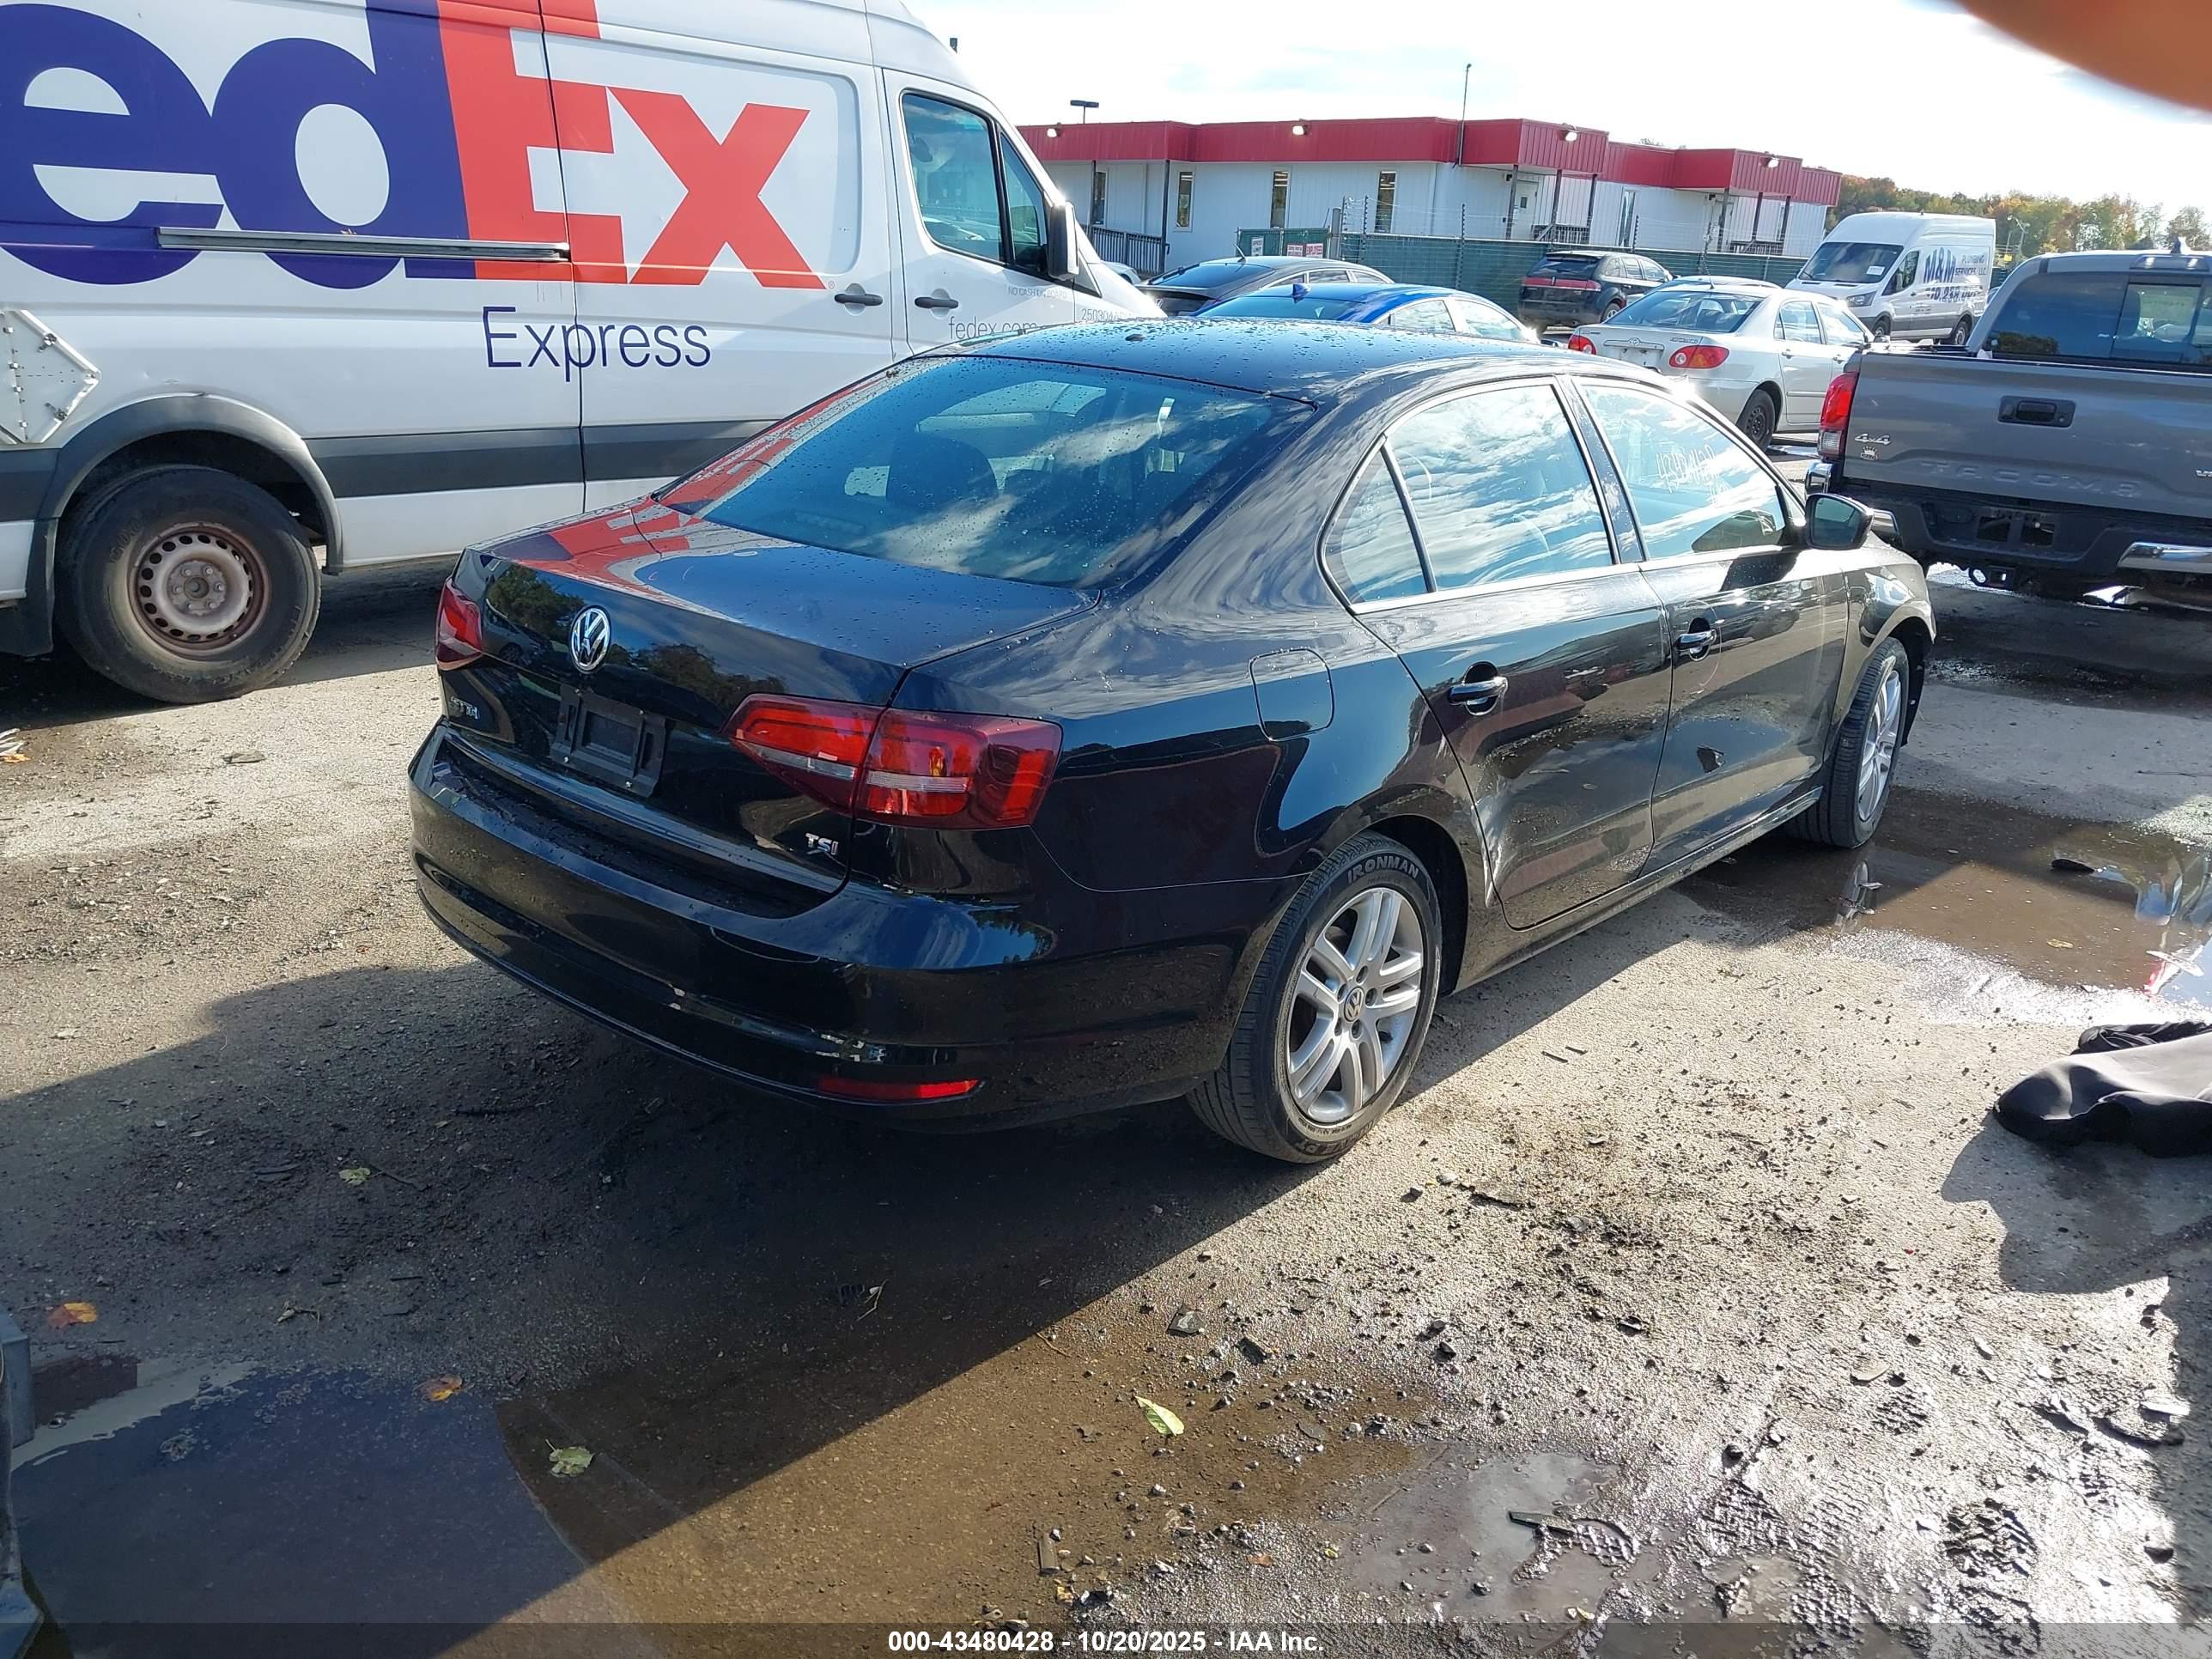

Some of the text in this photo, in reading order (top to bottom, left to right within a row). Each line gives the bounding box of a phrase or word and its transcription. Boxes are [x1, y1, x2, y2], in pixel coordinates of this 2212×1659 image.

[1923, 247, 1956, 283] M&M
[1008, 287, 1018, 295] NO
[1018, 288, 1036, 297] CASH
[483, 306, 711, 383] Express
[1921, 460, 2143, 499] TACOMA
[805, 832, 839, 855] TSI
[1347, 855, 1420, 884] IRONMAN
